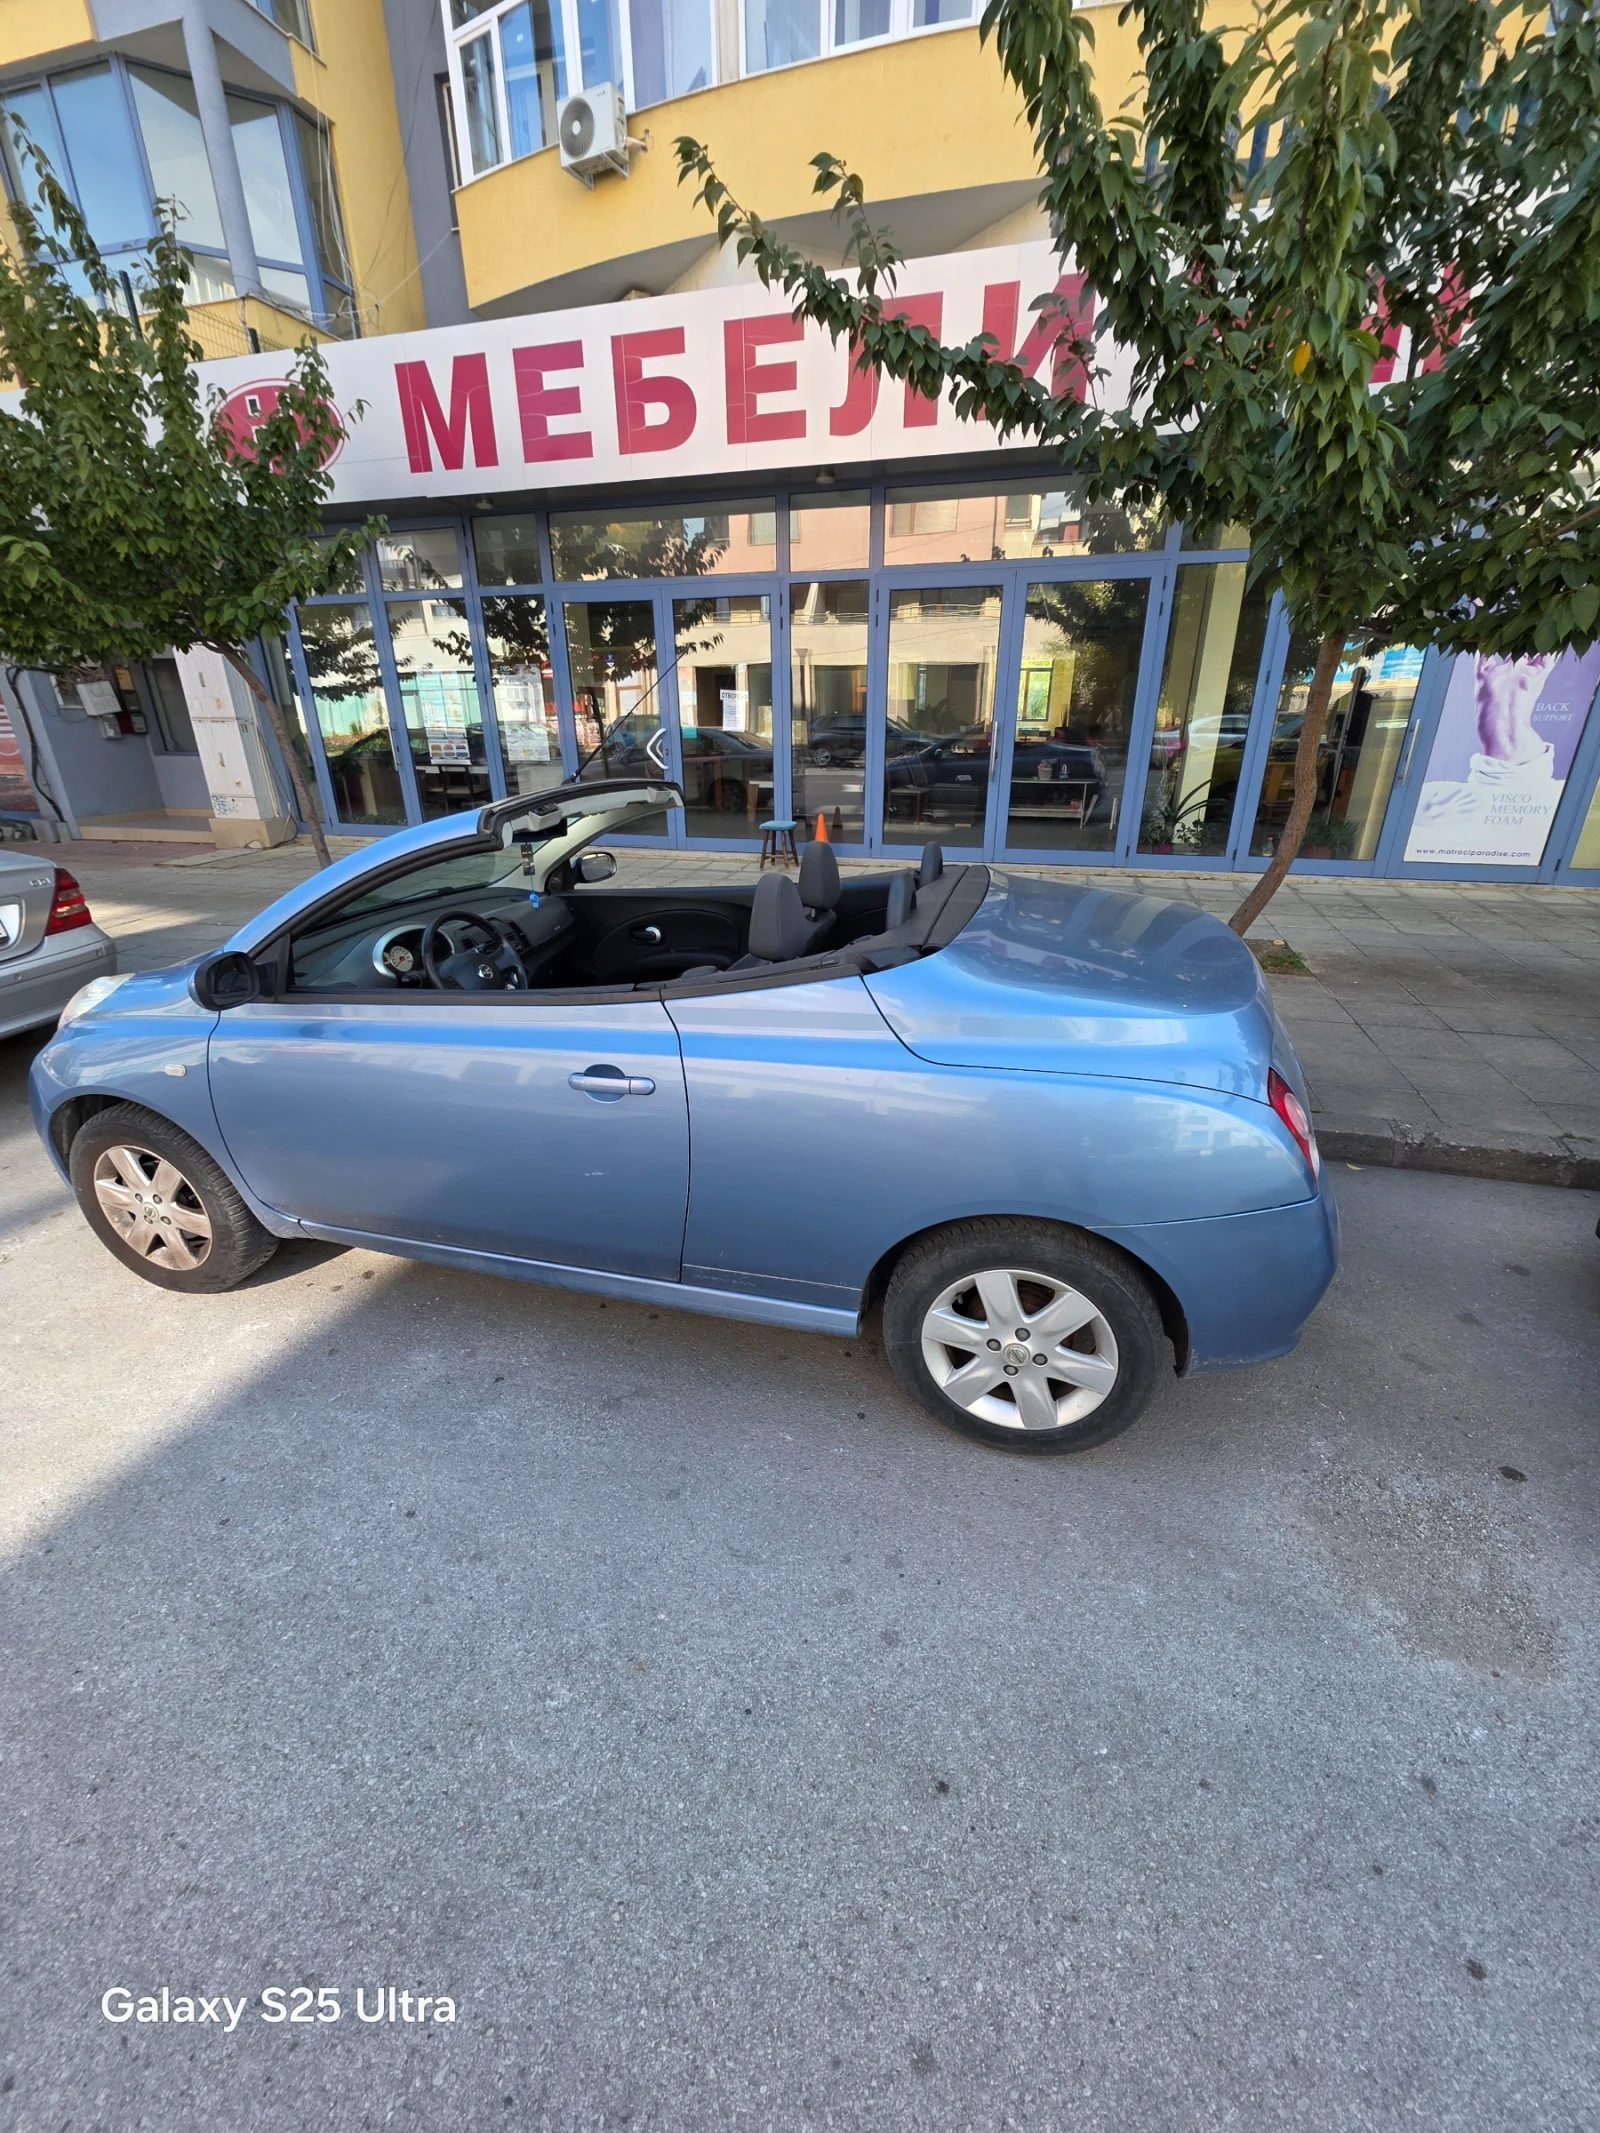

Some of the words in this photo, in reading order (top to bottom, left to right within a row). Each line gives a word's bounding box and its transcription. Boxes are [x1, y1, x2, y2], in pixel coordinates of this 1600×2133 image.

[394, 272, 1097, 474] МЕБЕЛИ
[1535, 702, 1571, 712] BACK
[1532, 713, 1574, 722] SUPPORT
[1491, 793, 1532, 804] VISCO
[1490, 804, 1552, 815] MEMORY
[1484, 815, 1524, 826] FOAM
[1416, 848, 1531, 858] www.matraciparadise.com
